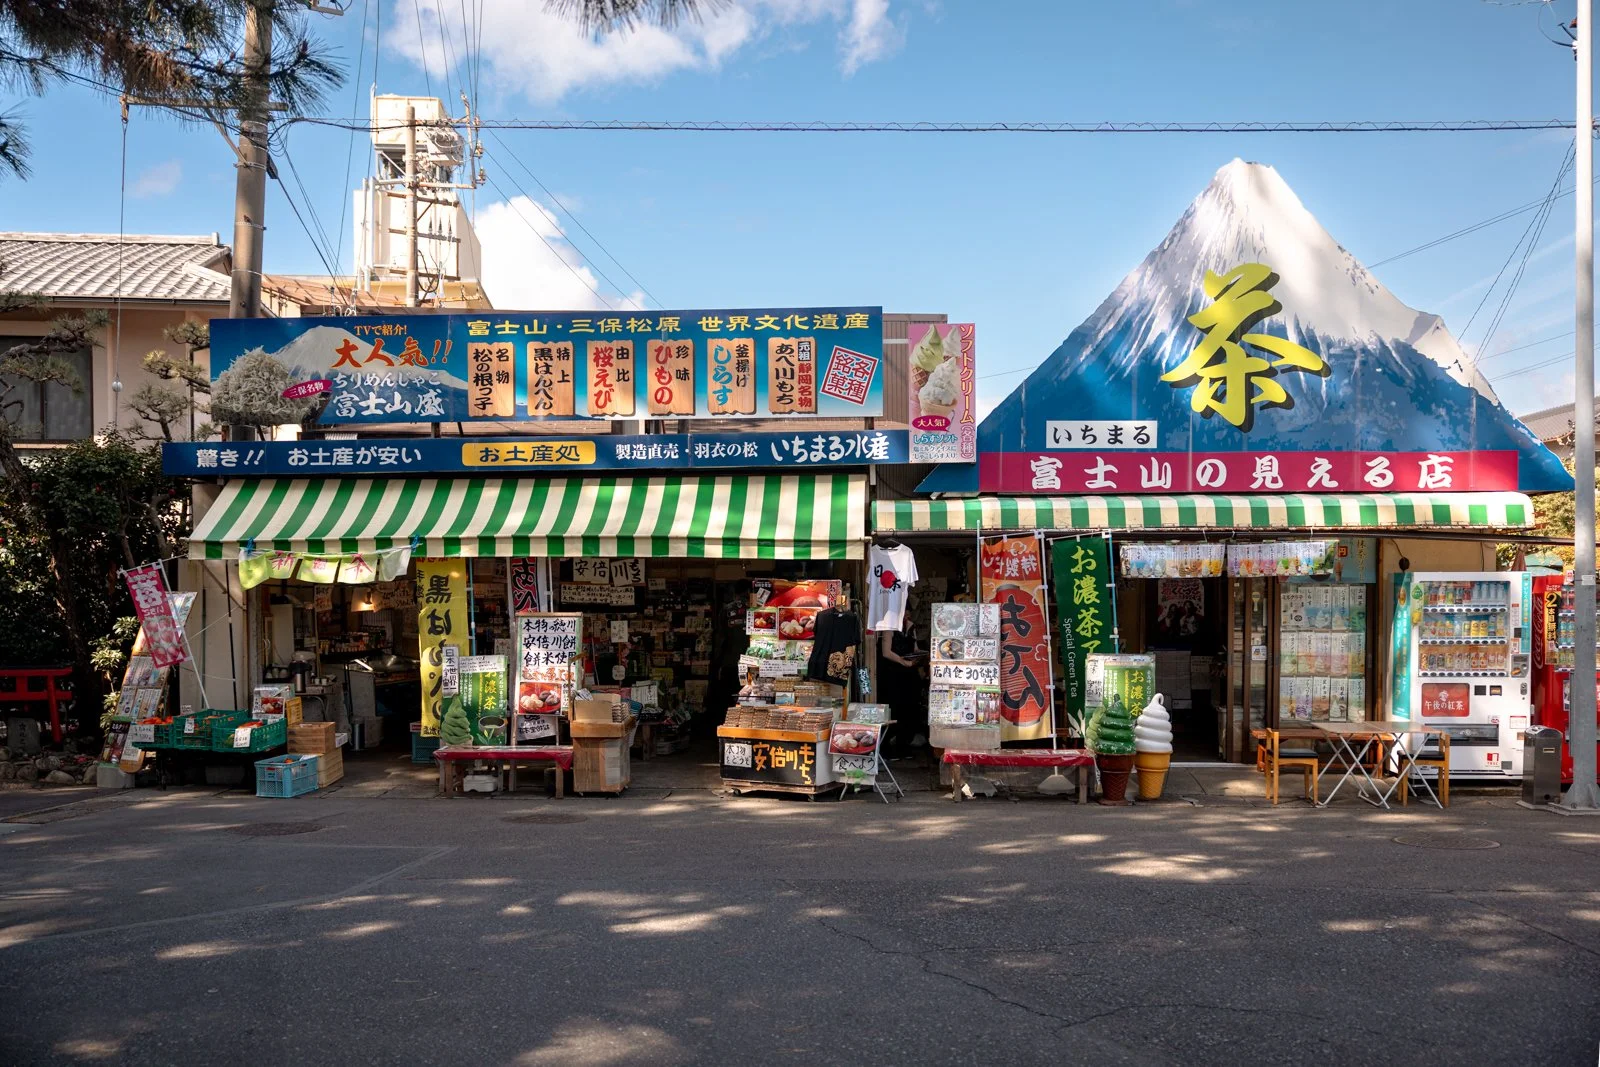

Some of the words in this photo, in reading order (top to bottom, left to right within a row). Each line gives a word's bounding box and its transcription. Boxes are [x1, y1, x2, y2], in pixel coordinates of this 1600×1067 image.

[354, 324, 407, 337] TVで紹介!
[467, 316, 681, 337] 富士山・三保松原
[697, 313, 870, 332] 世界文化遺産
[331, 337, 453, 369] 大人気!!
[556, 347, 571, 384] 特上
[615, 346, 631, 383] 由比
[675, 345, 690, 382] 珍味
[735, 344, 751, 388] 釜揚げ
[1160, 262, 1332, 433] 茶
[332, 371, 441, 389] ちりめんじゃこ
[473, 348, 494, 411] 松の根っ子
[495, 348, 510, 385] 名物
[533, 347, 555, 411] 黒はんぺん
[592, 346, 615, 410] 桜えび
[654, 345, 674, 406] ひもの
[712, 345, 733, 406] しらす
[774, 343, 795, 406] あべ川もち
[797, 362, 812, 407] 静岡名物
[827, 354, 854, 394] 銘菓
[847, 360, 870, 399] 各種
[960, 325, 975, 424] ソフトクリーム
[284, 381, 324, 399] 三保名物
[288, 447, 422, 467] お土産が安い
[479, 445, 580, 464] お土産処
[615, 442, 759, 462] 製造直売・羽衣の松
[770, 431, 890, 464] いちまる水産
[1051, 426, 1152, 446] いちまる
[1030, 454, 1455, 491] 富士山の見える店
[1063, 618, 1076, 649] Special
[1066, 652, 1077, 679] Green
[1070, 681, 1078, 698] Tea
[1424, 700, 1463, 711] 午後の紅茶
[753, 742, 816, 785] 安倍川もち
[835, 756, 876, 771] 食べよう
